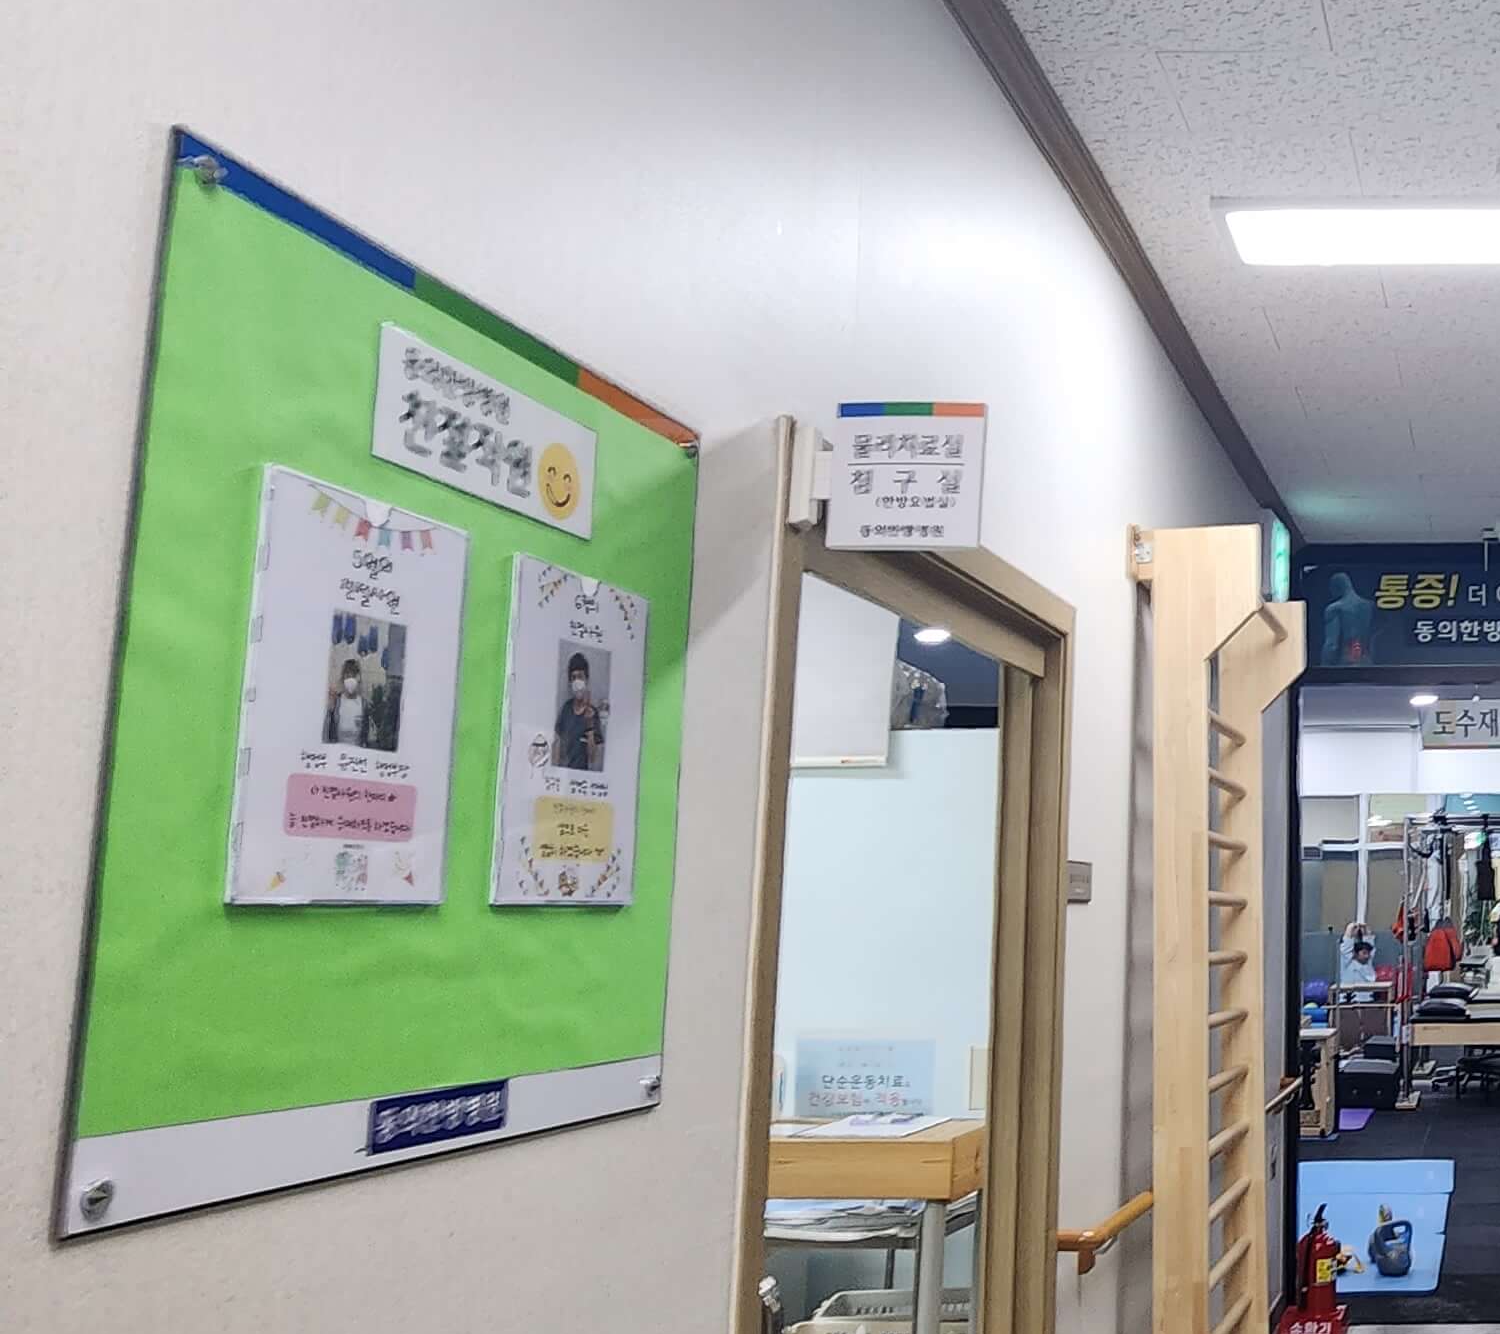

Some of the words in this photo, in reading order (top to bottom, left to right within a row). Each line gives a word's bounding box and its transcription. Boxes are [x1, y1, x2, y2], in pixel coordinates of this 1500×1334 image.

[852, 434, 965, 460] 물리치료실
[860, 524, 945, 538] 동의한방병원
[1375, 573, 1460, 610] 통증!
[1468, 583, 1488, 607] 더
